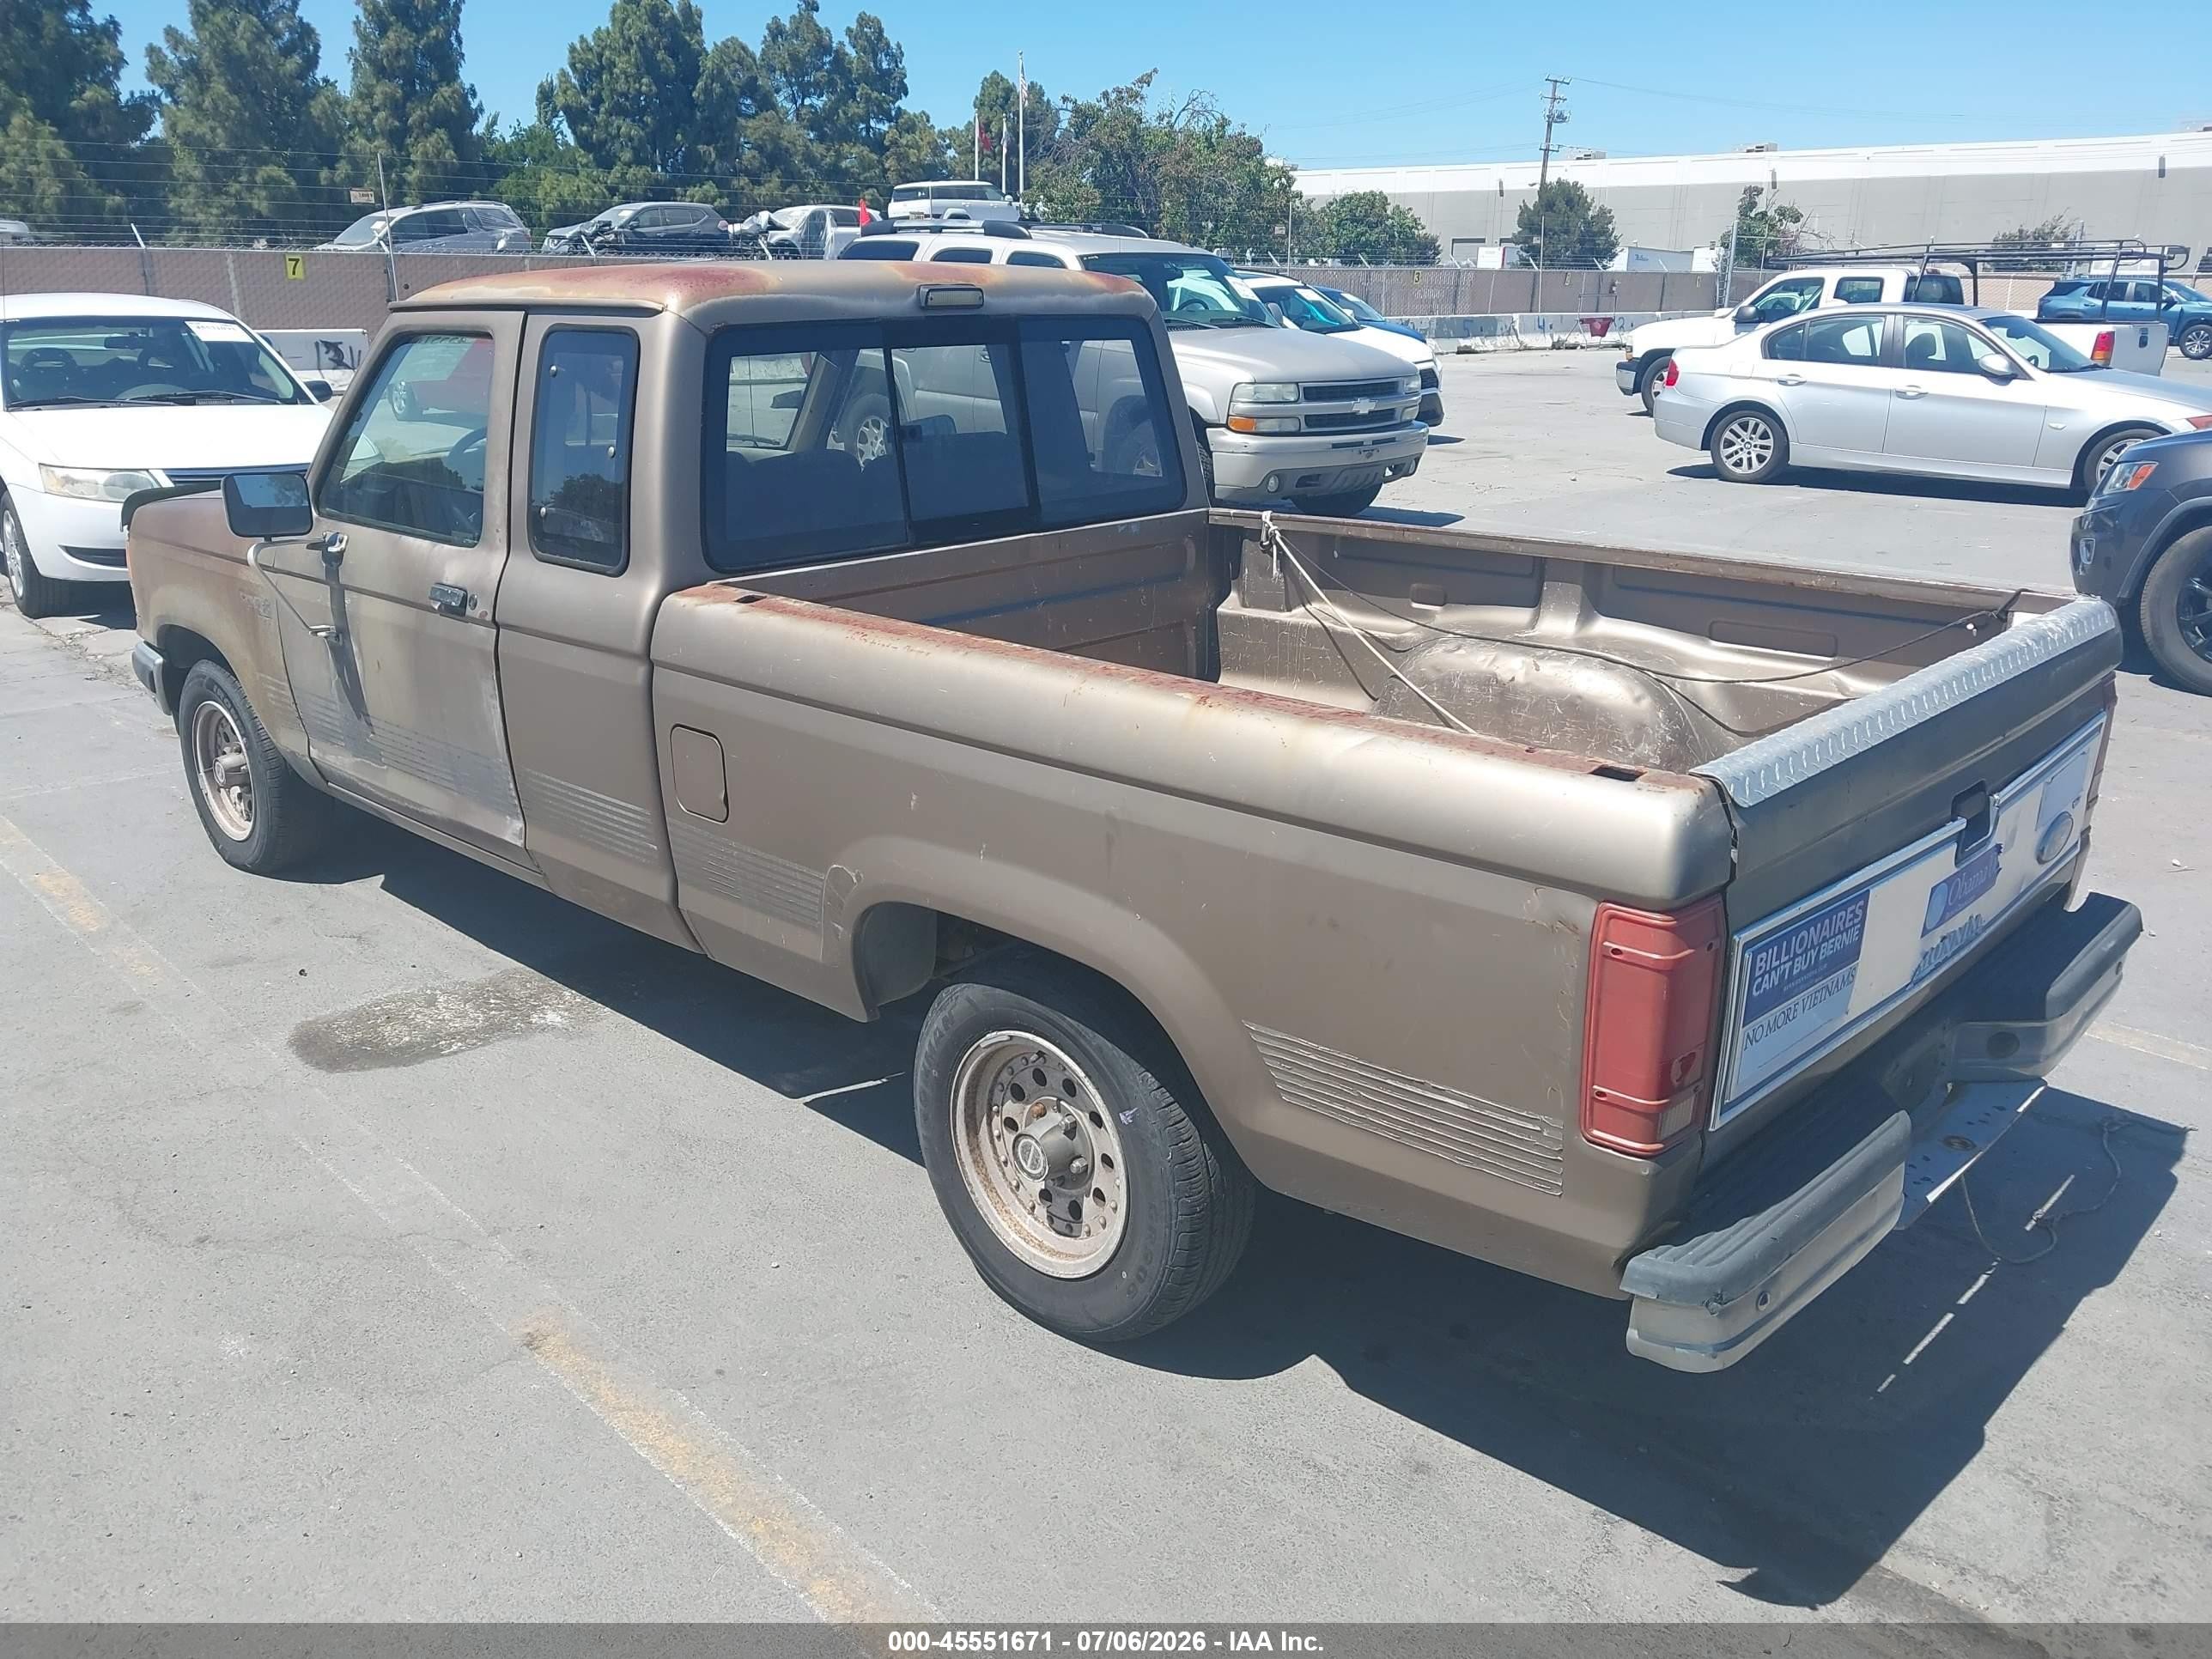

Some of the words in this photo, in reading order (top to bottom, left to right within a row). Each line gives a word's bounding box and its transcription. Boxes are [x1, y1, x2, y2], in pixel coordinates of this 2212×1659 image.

[288, 258, 301, 276] 7
[1414, 271, 1420, 283] 3
[1752, 959, 1794, 997] CAN'T
[1792, 946, 1820, 975] BUY
[1819, 924, 1862, 960] BERNIE
[1754, 900, 1865, 978] BILLIONAIRES
[1743, 1024, 1765, 1052] NO
[1763, 1001, 1800, 1038] MORE
[1802, 966, 1858, 1014] VIETNAMS
